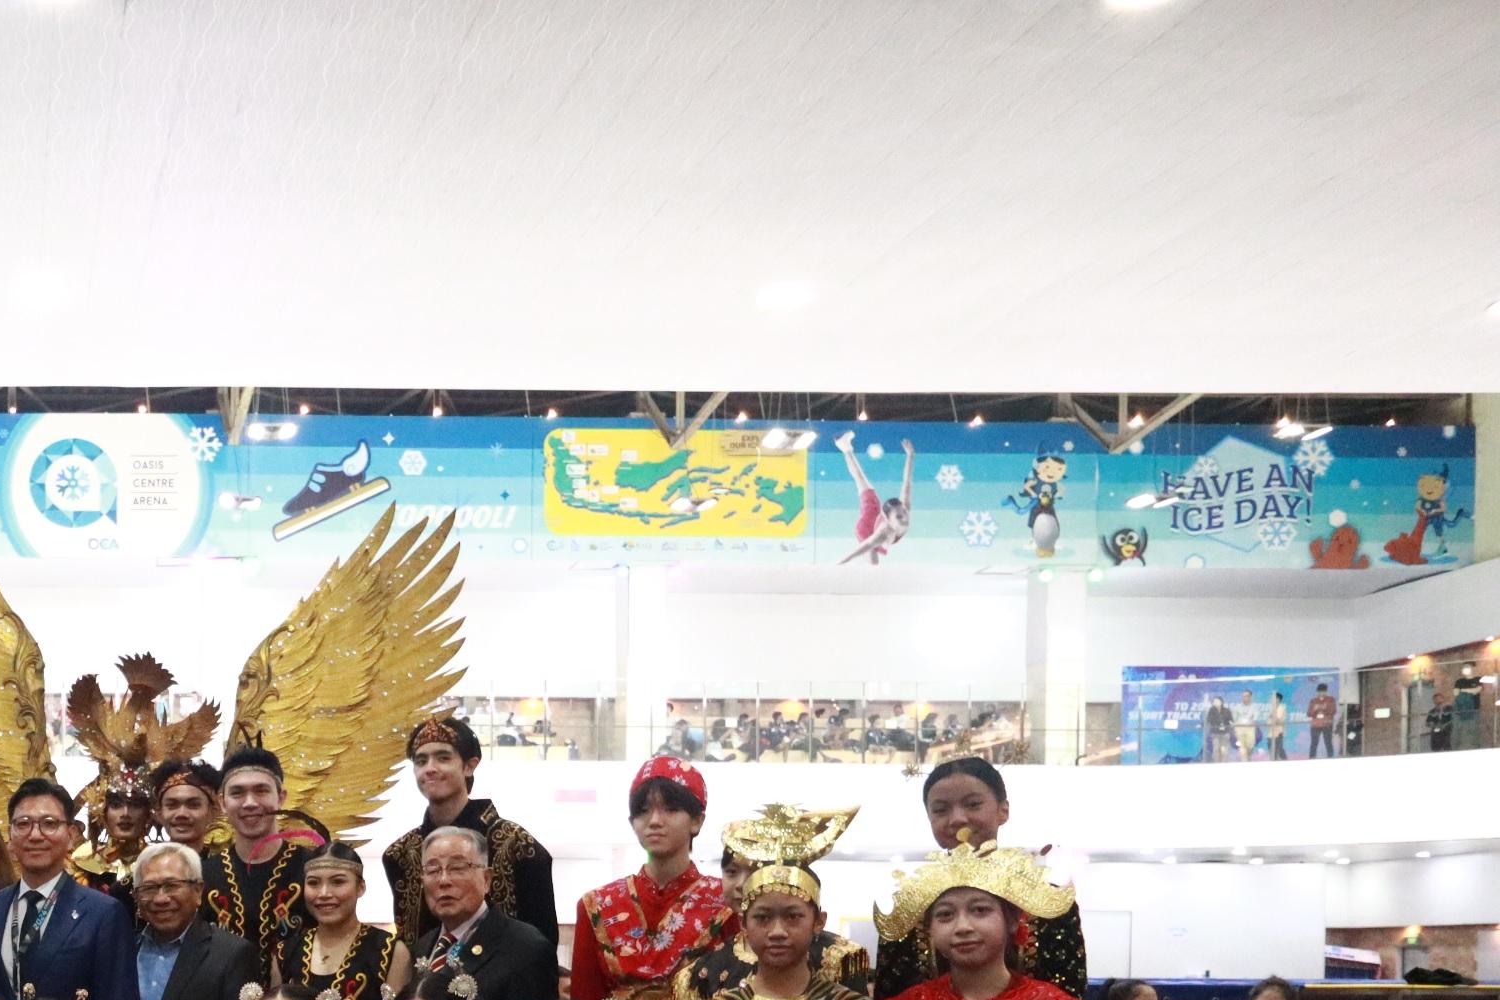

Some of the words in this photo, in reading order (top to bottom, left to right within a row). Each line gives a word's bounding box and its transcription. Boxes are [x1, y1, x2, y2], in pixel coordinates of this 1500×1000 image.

[133, 460, 164, 470] OASIS
[133, 478, 174, 488] CENTRE
[1263, 463, 1315, 494] AN
[133, 496, 168, 505] ARENA
[1171, 504, 1224, 533] ICE
[1234, 494, 1311, 526] DAY!
[1167, 711, 1202, 720] TRACK
